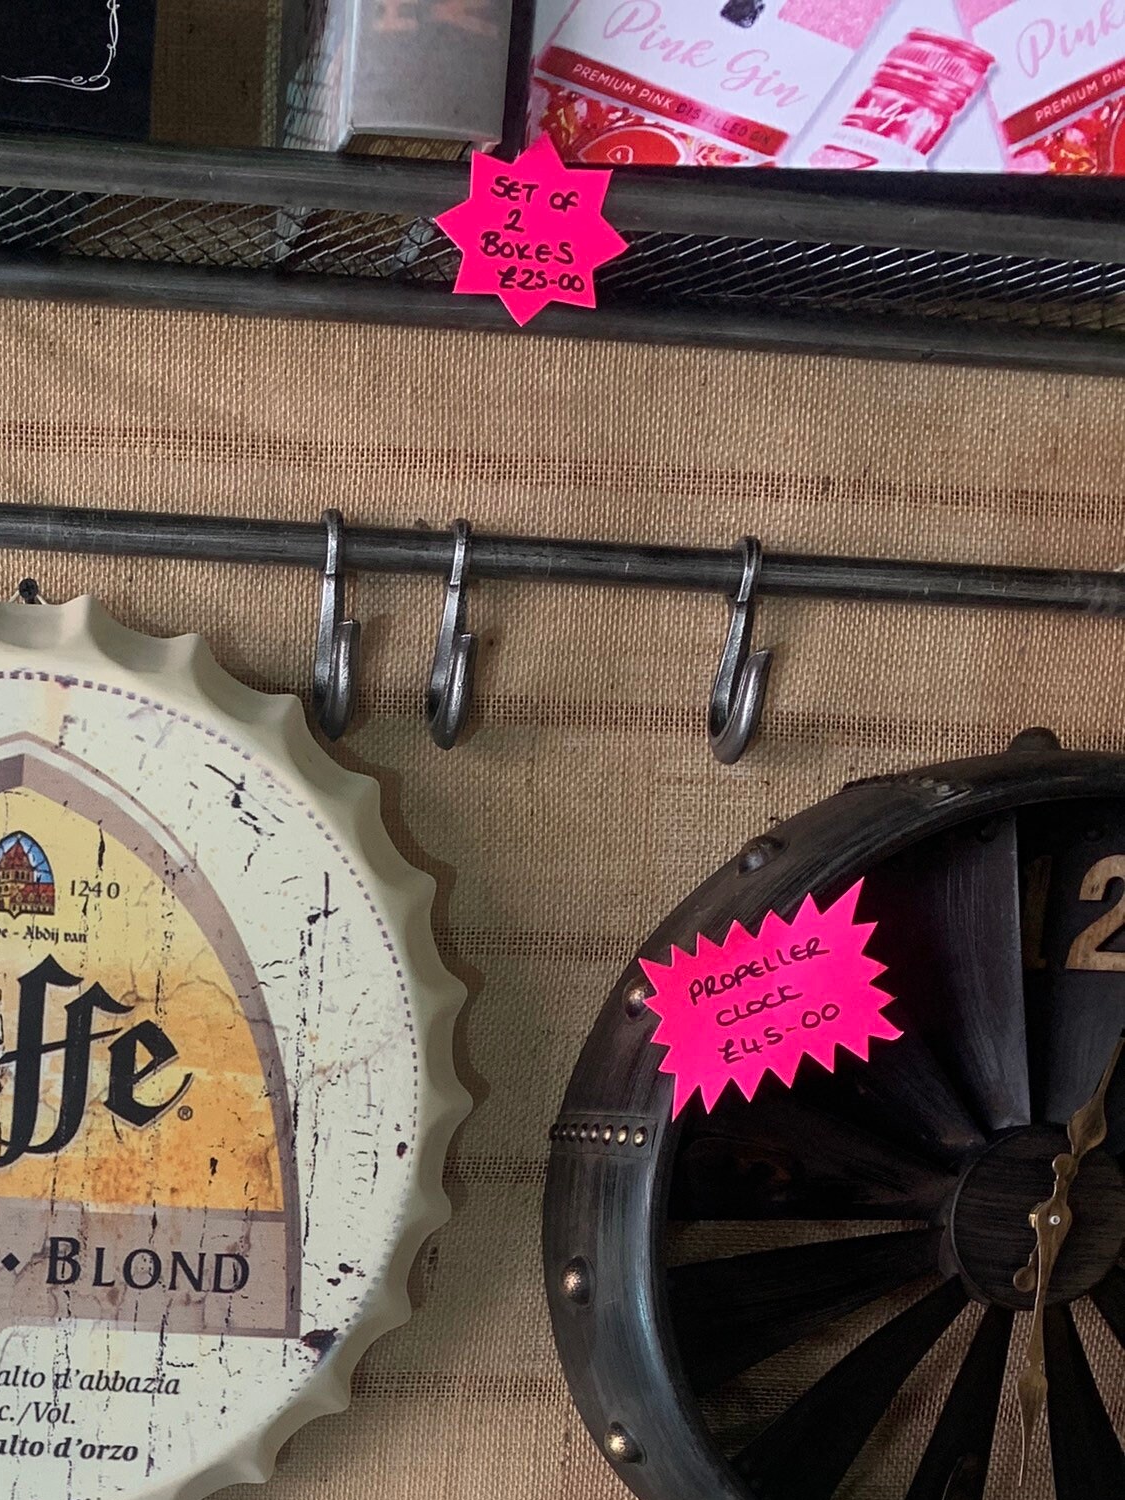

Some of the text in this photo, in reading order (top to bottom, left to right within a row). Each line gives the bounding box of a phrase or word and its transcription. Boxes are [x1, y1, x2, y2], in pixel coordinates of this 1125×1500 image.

[603, 0, 808, 107] Pink Gin
[572, 62, 637, 95] PREMIUM
[638, 88, 673, 111] PINK
[675, 102, 747, 138] DISTILLED
[1035, 81, 1100, 123] PREMIUM
[490, 175, 539, 203] SET
[503, 209, 525, 233] 2
[480, 230, 574, 265] BOXES
[69, 879, 121, 900] 1240
[22, 923, 59, 943] Abdij
[63, 930, 87, 943] van
[688, 937, 831, 1006] PROPELLER
[716, 984, 803, 1027] CLOCK
[46, 1236, 251, 1294] BLOND
[53, 1369, 181, 1396] d'abbazia
[53, 1437, 139, 1462] d'orzo
